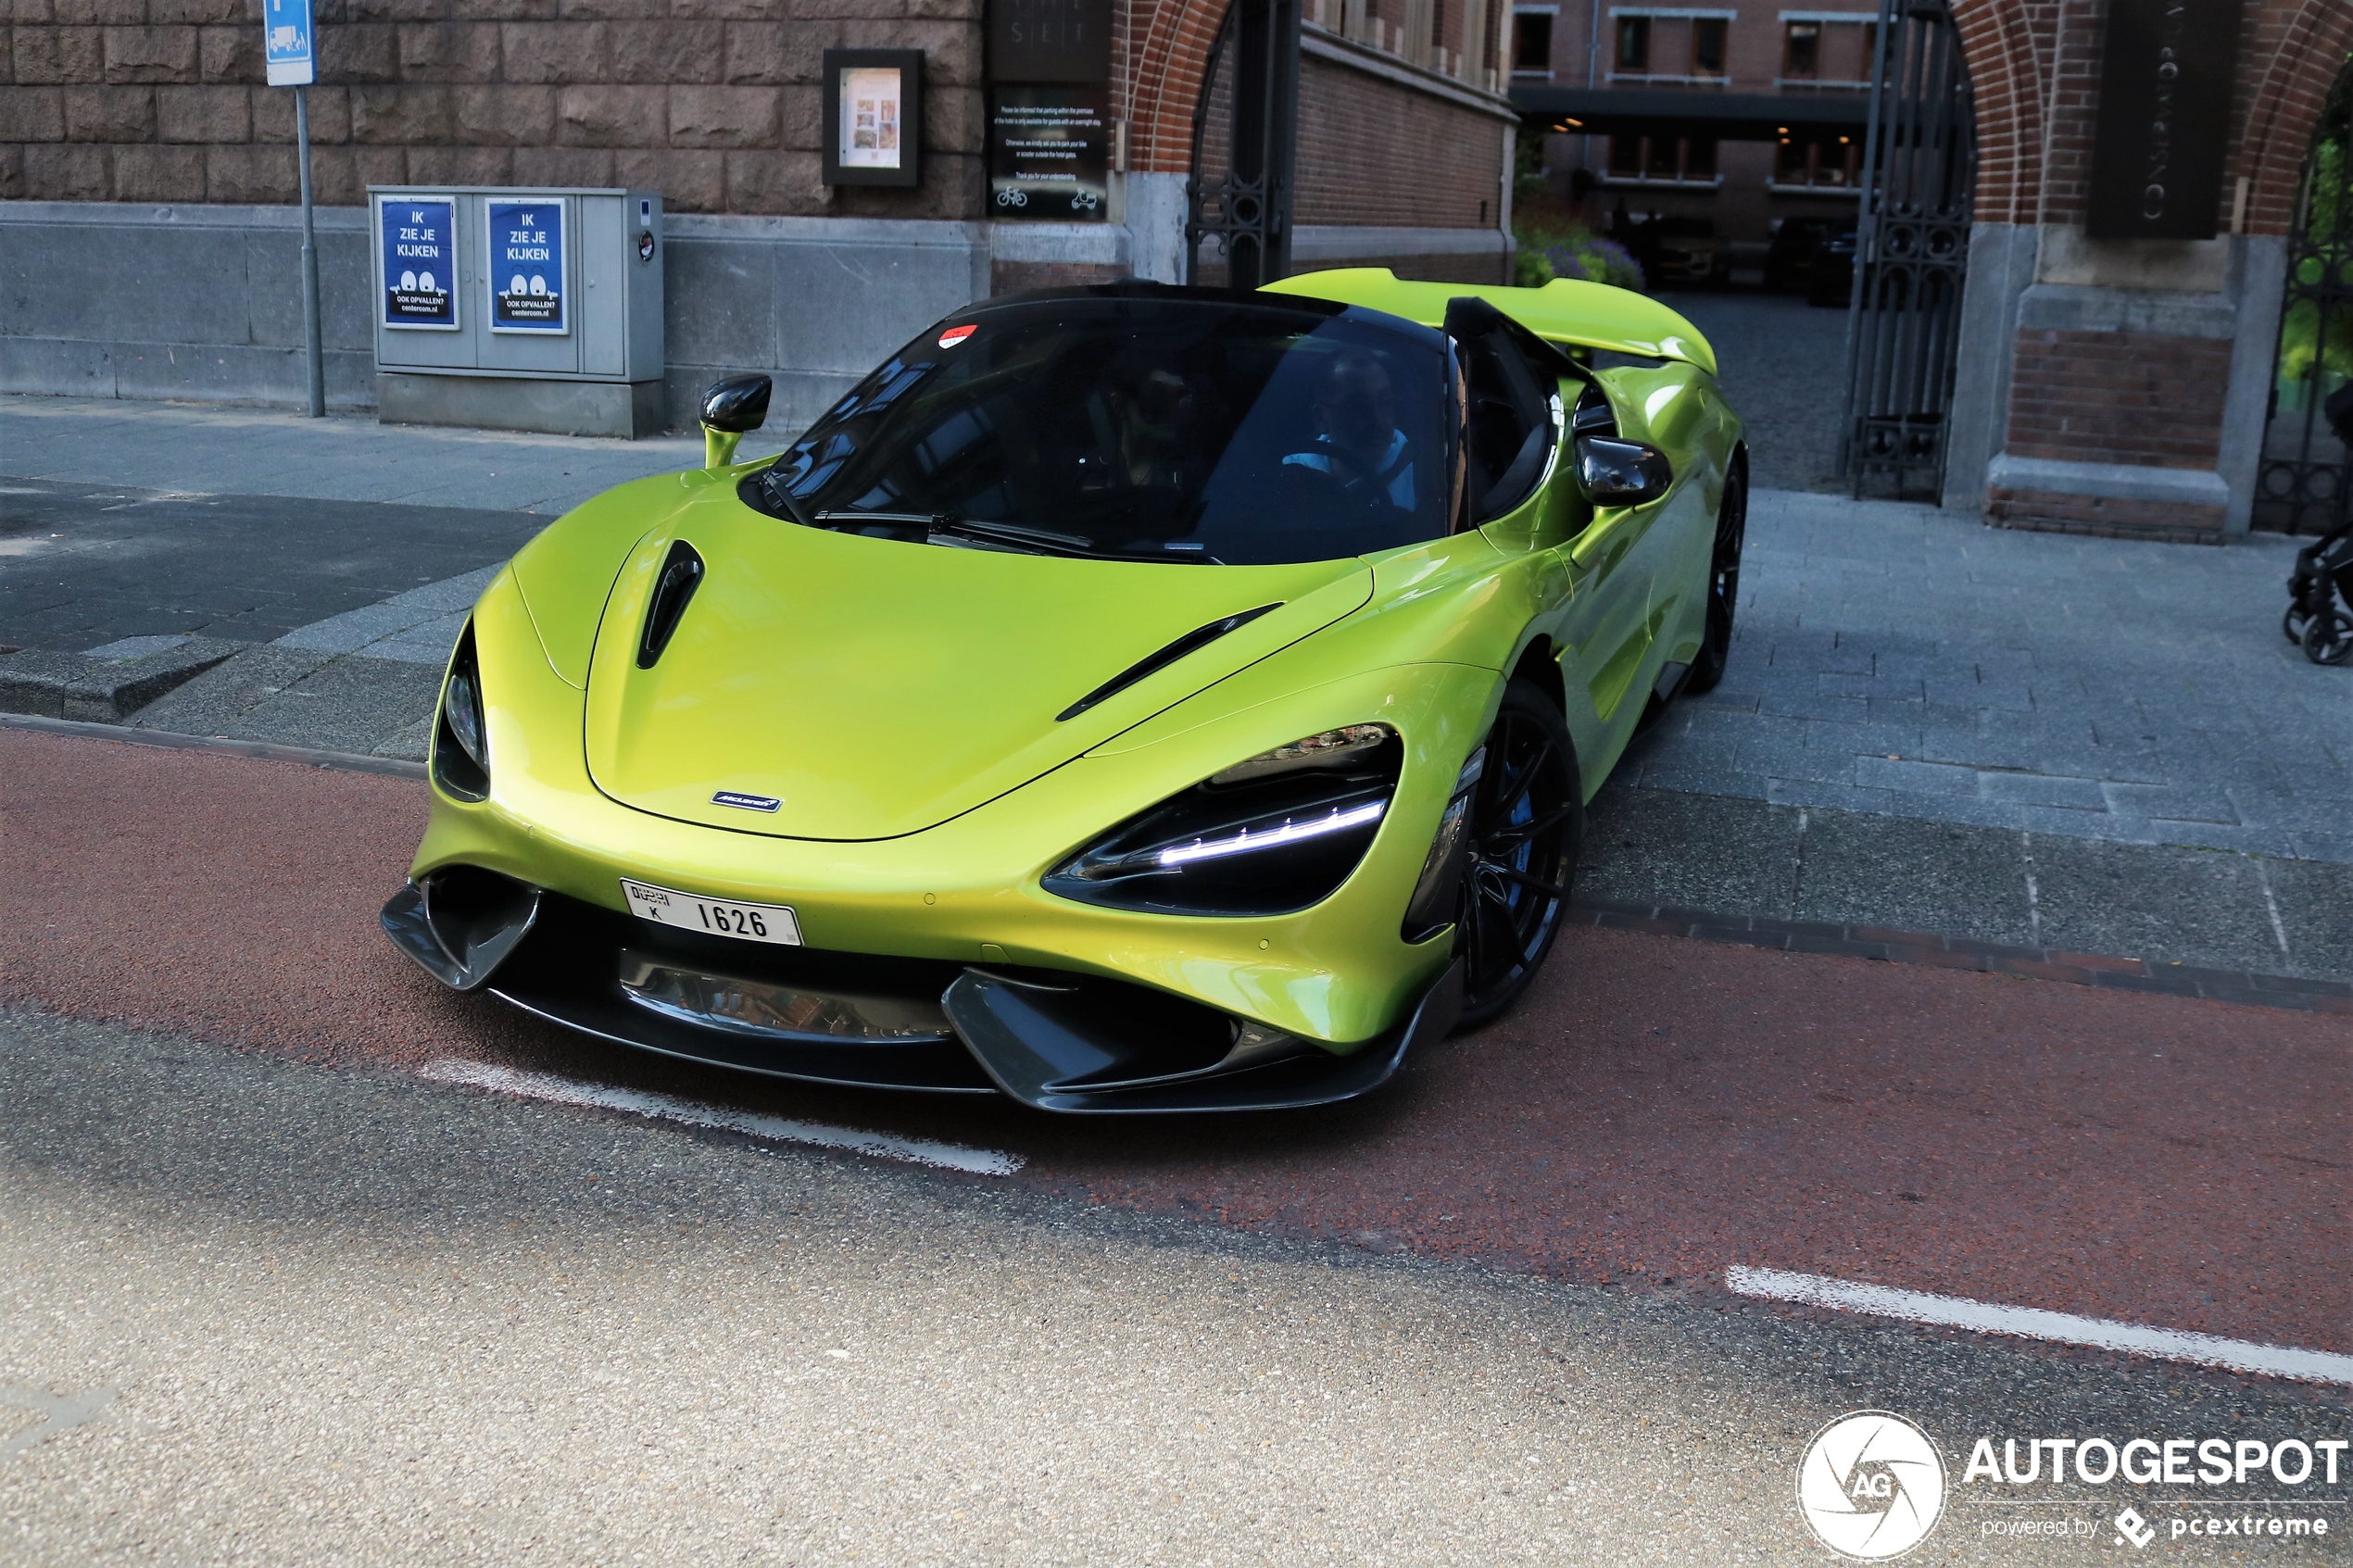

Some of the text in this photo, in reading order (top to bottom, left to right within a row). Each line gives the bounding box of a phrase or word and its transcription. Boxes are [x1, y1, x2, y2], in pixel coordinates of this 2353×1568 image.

[411, 211, 424, 223] IK
[522, 214, 535, 226] IK
[399, 227, 435, 241] ZIE JE
[510, 231, 547, 244] ZIE JE
[396, 244, 439, 257] KIJKEN
[507, 248, 549, 260] KIJKEN
[410, 296, 445, 305] OPVALLEN?
[521, 300, 556, 308] OPVALLEN?
[717, 795, 774, 806] McLaren
[649, 903, 767, 937] K 1626
